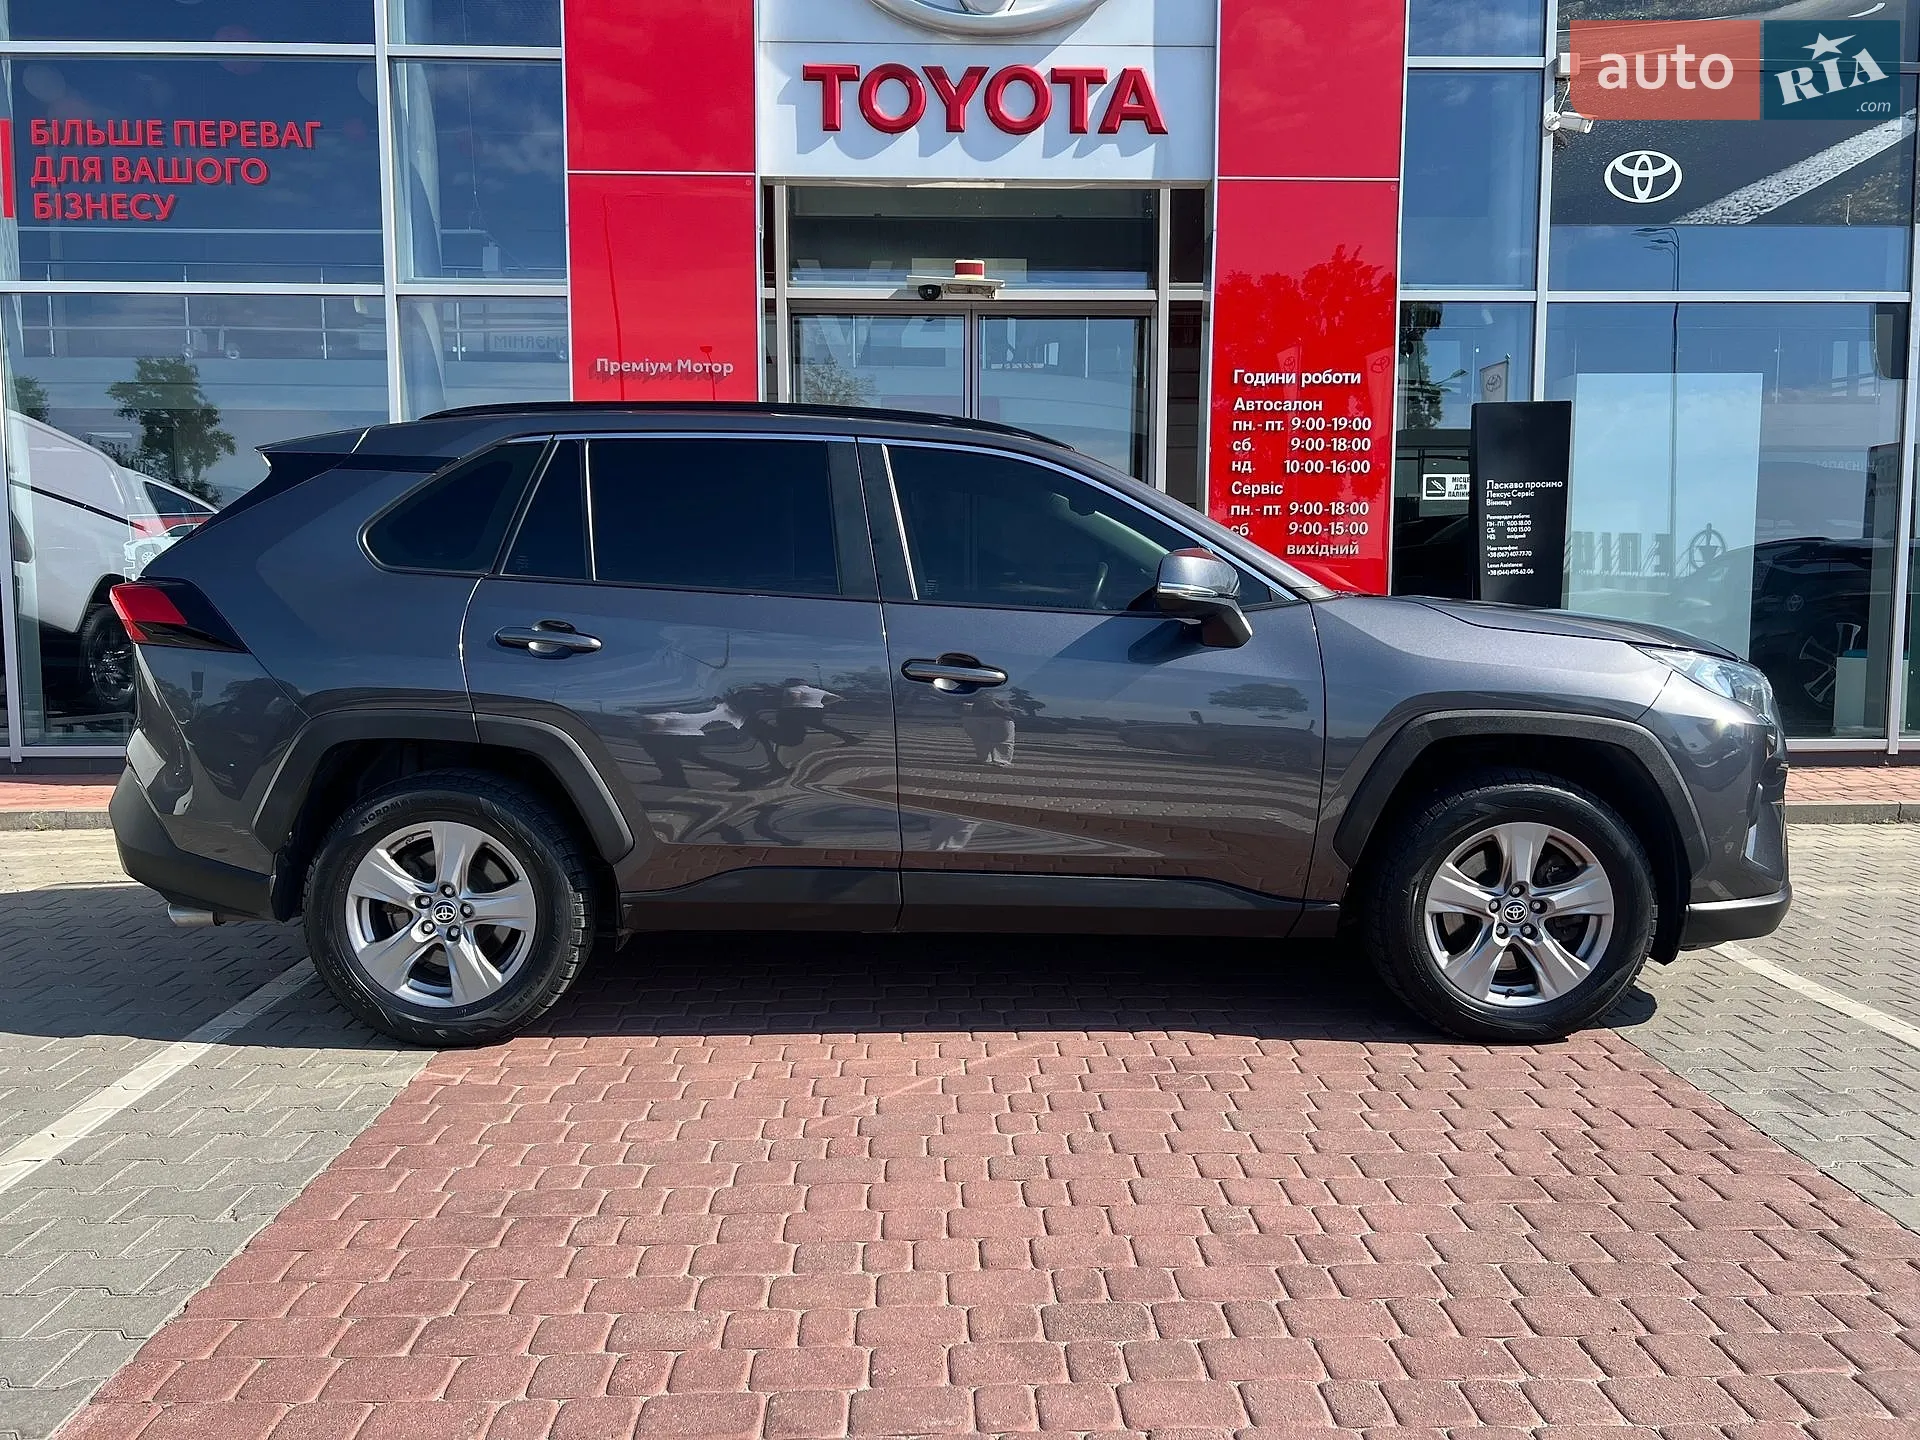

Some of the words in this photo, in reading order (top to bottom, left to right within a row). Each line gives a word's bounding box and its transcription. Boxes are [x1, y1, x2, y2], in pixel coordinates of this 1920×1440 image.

[802, 63, 1169, 135] TOYOTA
[30, 119, 164, 147] БІЛЬШЕ
[174, 120, 321, 148] ПЕРЕВАГ
[30, 156, 102, 188] ДЛЯ
[111, 156, 268, 185] ВАШОГО
[33, 193, 175, 220] БІЗНЕСУ
[596, 358, 672, 376] Преміум
[677, 359, 734, 376] Мотор
[1233, 369, 1296, 386] Години
[1301, 369, 1361, 387] роботи
[1233, 397, 1323, 411] Автосалон
[1291, 417, 1372, 431] 9:00-19:00
[1232, 437, 1255, 451] сб.
[1290, 437, 1371, 451] 9:00-18:00
[1231, 460, 1256, 473] нд.
[1284, 459, 1371, 474] 10:00-16:00
[1231, 480, 1284, 497] Сервіс
[1486, 480, 1524, 490] Ласкаво
[1525, 481, 1563, 490] просимо
[1486, 490, 1511, 499] Лексус
[1511, 489, 1535, 498] Сервіс
[1289, 501, 1369, 516] 9:00-18:00
[1486, 499, 1512, 507] Вінниця
[1289, 521, 1369, 536] 9:00-15:00
[1287, 542, 1359, 556] вихідний
